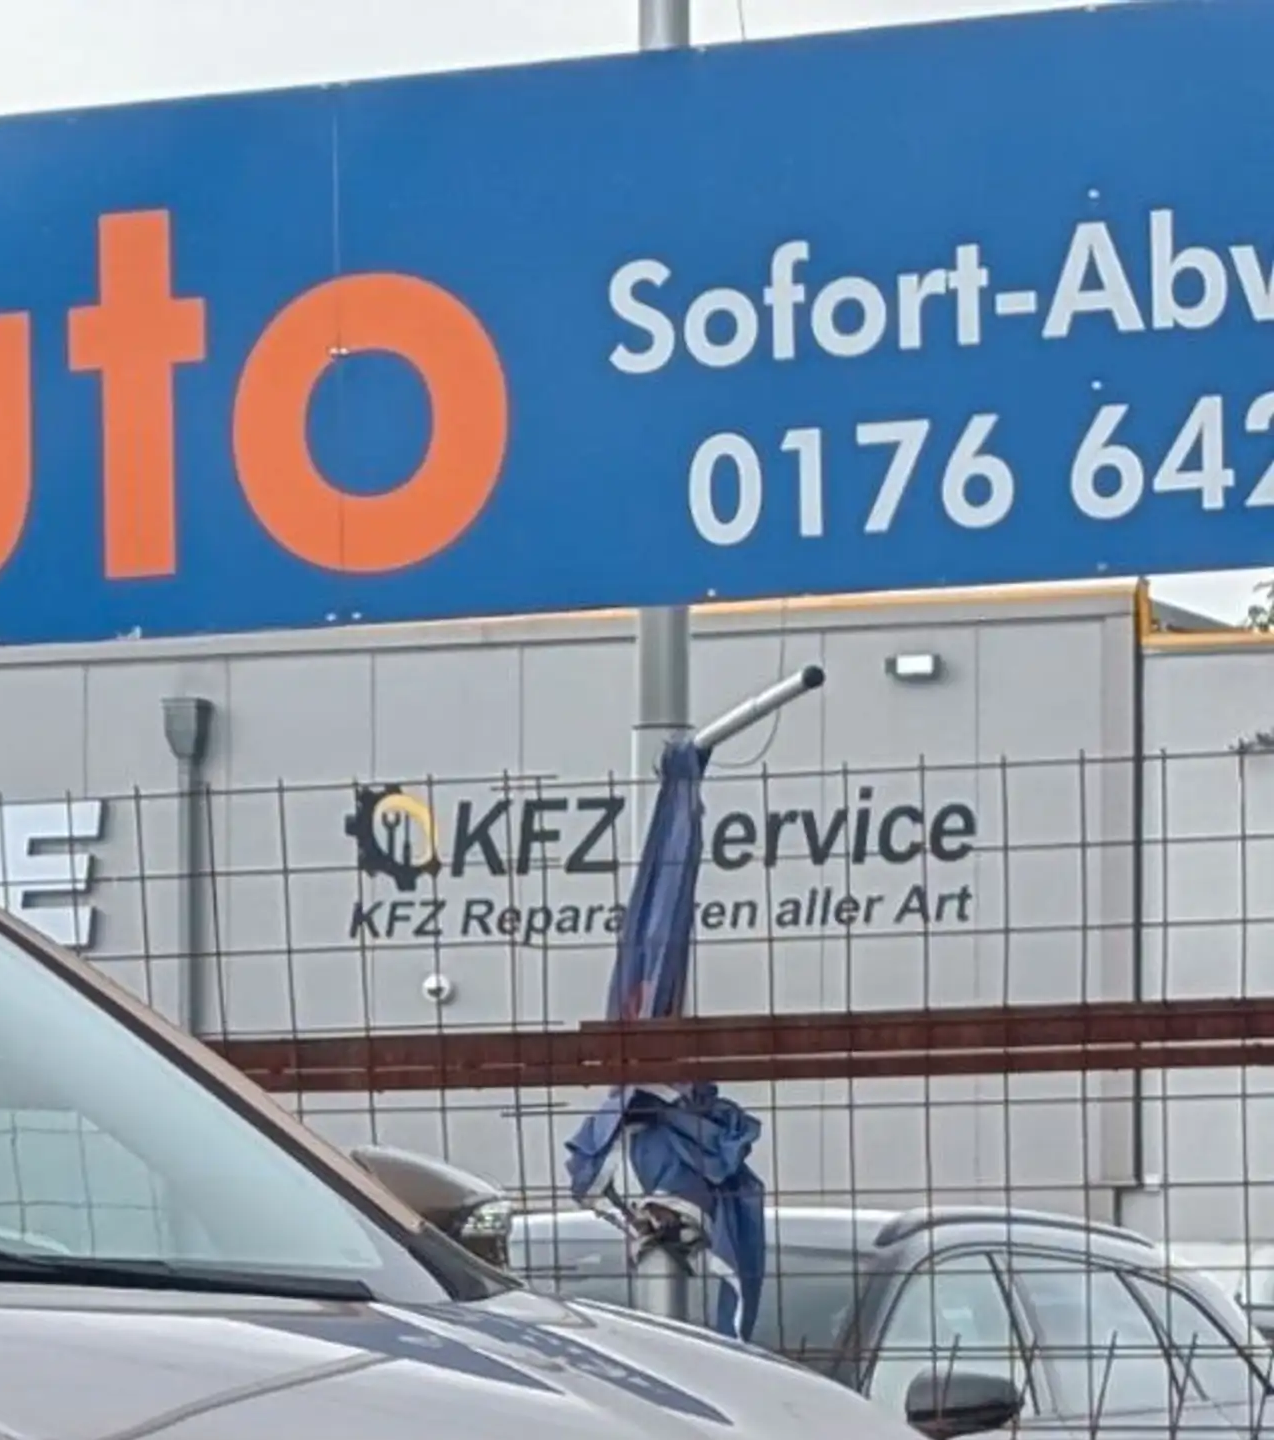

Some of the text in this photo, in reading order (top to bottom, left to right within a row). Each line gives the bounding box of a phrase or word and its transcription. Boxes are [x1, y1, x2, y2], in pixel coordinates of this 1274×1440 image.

[687, 413, 1016, 547] 0176
[451, 786, 977, 877] KFZ ervice
[349, 884, 973, 947] KFZ Reparaen aller Art
